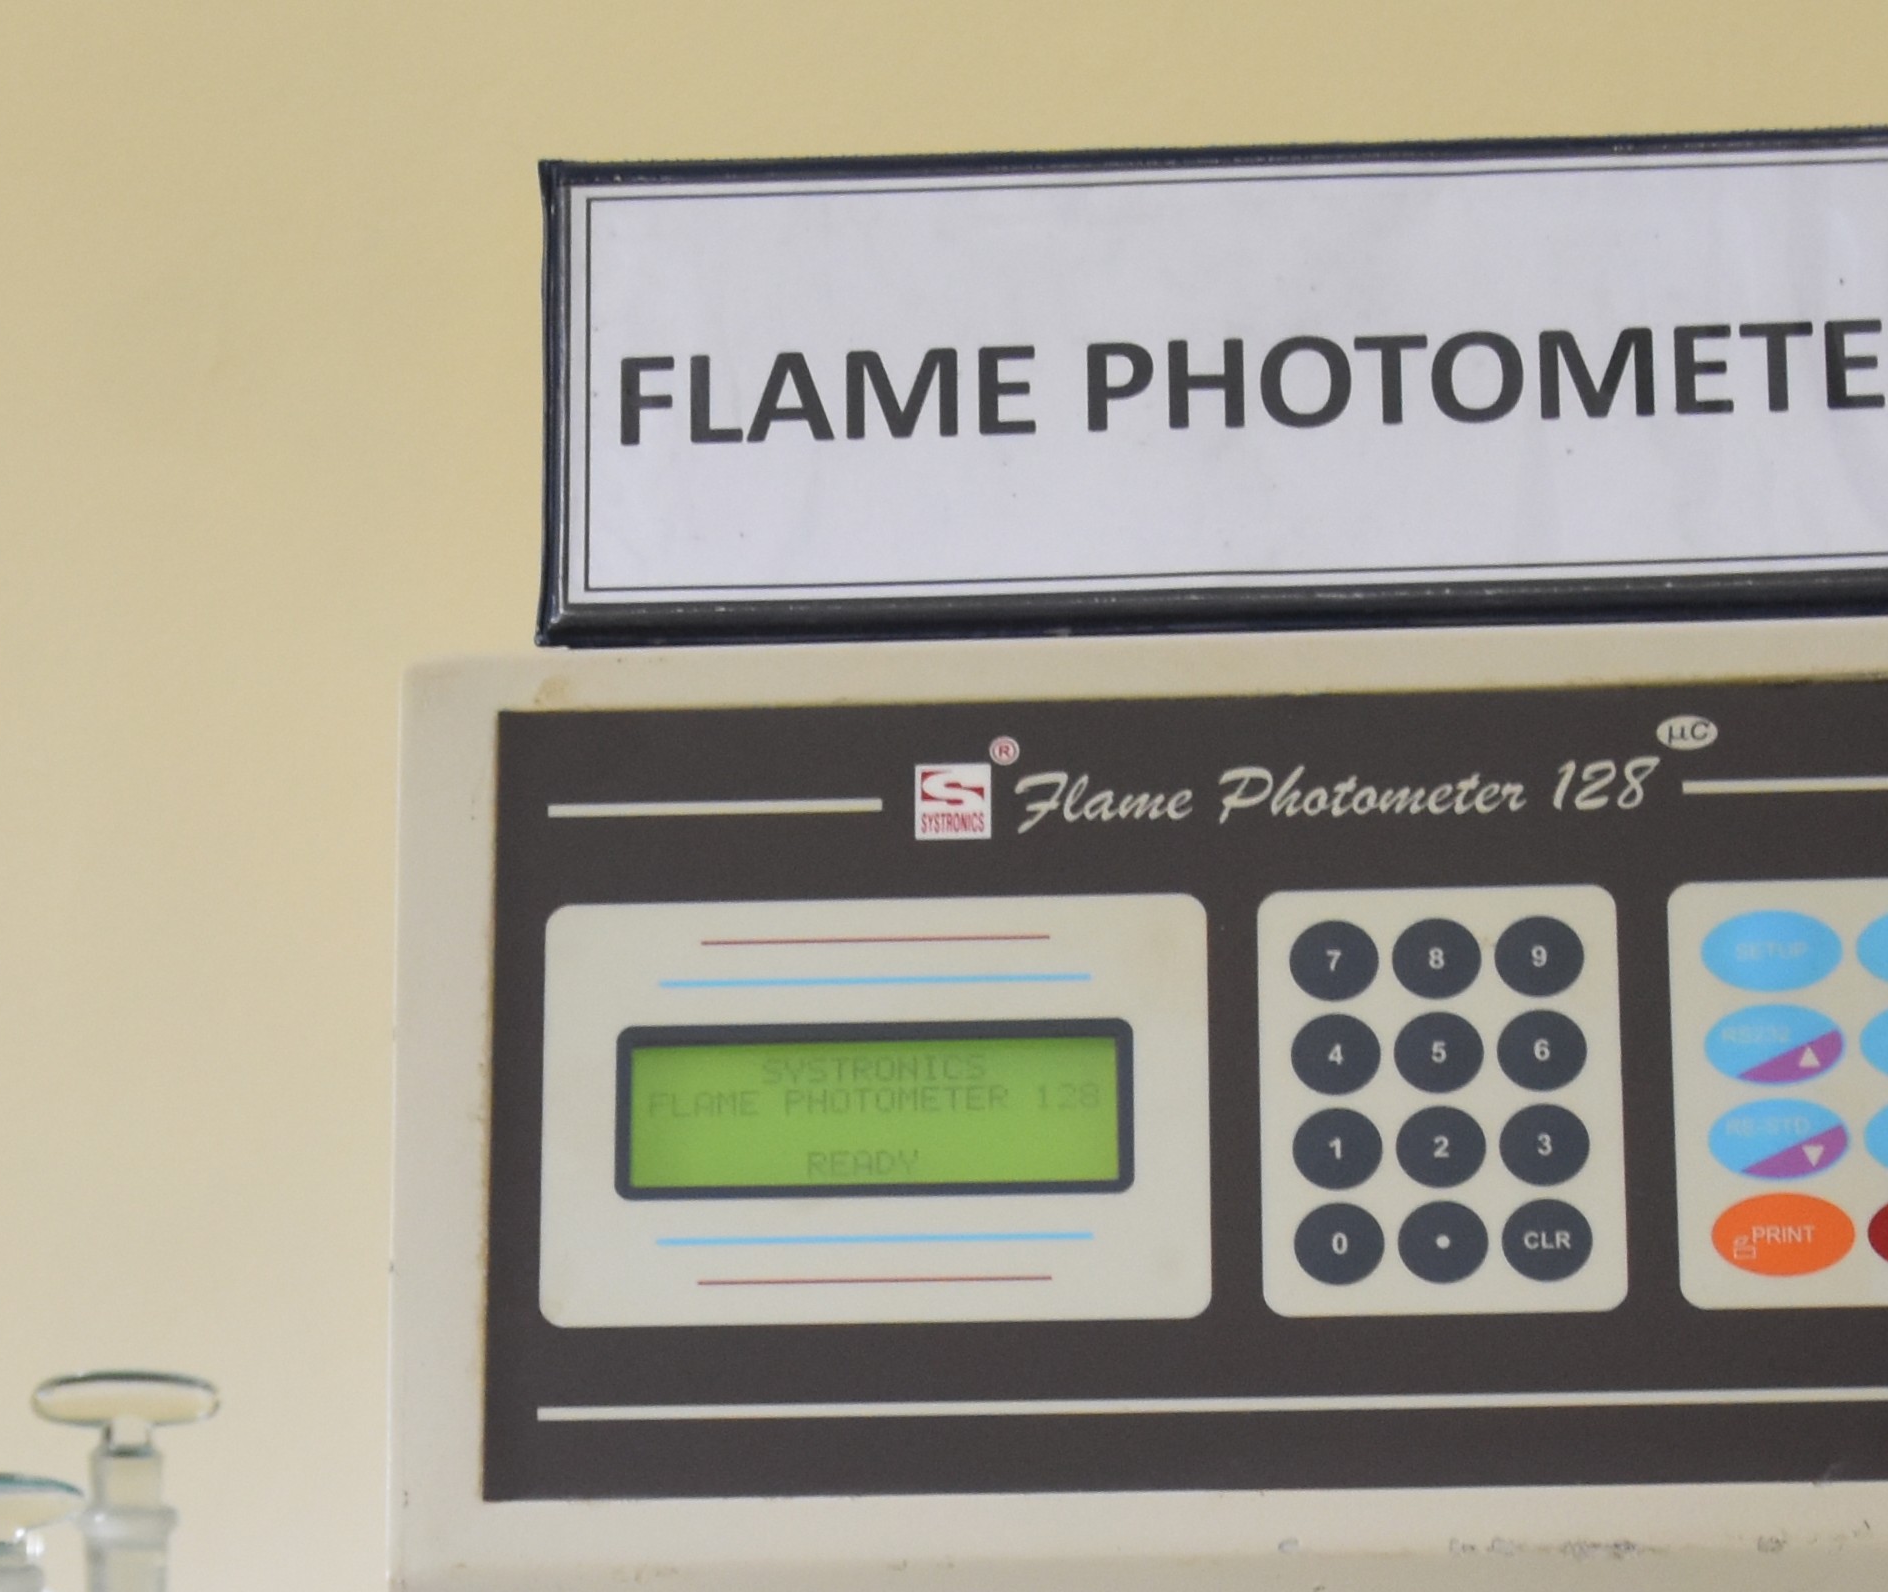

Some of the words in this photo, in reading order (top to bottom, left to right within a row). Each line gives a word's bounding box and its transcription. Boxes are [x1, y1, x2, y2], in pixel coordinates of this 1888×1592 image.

[619, 344, 1036, 447] FLAME
[1014, 771, 1193, 835] Flame
[1218, 764, 1527, 825] Photometer
[1551, 755, 1661, 812] 128
[921, 812, 985, 834] SYSTRONICS
[1326, 949, 1342, 971] 7
[1428, 947, 1445, 970] 8
[1530, 944, 1548, 967] 9
[1735, 940, 1808, 963] SETUP
[1328, 1043, 1344, 1065] 4
[1431, 1041, 1447, 1063] 5
[1533, 1038, 1551, 1061] 6
[761, 1054, 987, 1086] SYSTRONICS
[648, 1089, 761, 1119] FLAME
[784, 1085, 1010, 1116] PHOTOMETER
[1035, 1083, 1102, 1111] 128
[1328, 1137, 1343, 1159] 1
[1433, 1135, 1450, 1158] 2
[1537, 1133, 1553, 1156] 3
[807, 1149, 920, 1178] READY
[1331, 1232, 1348, 1255] 0
[1523, 1230, 1571, 1250] CLR
[1751, 1224, 1816, 1245] PRINT
